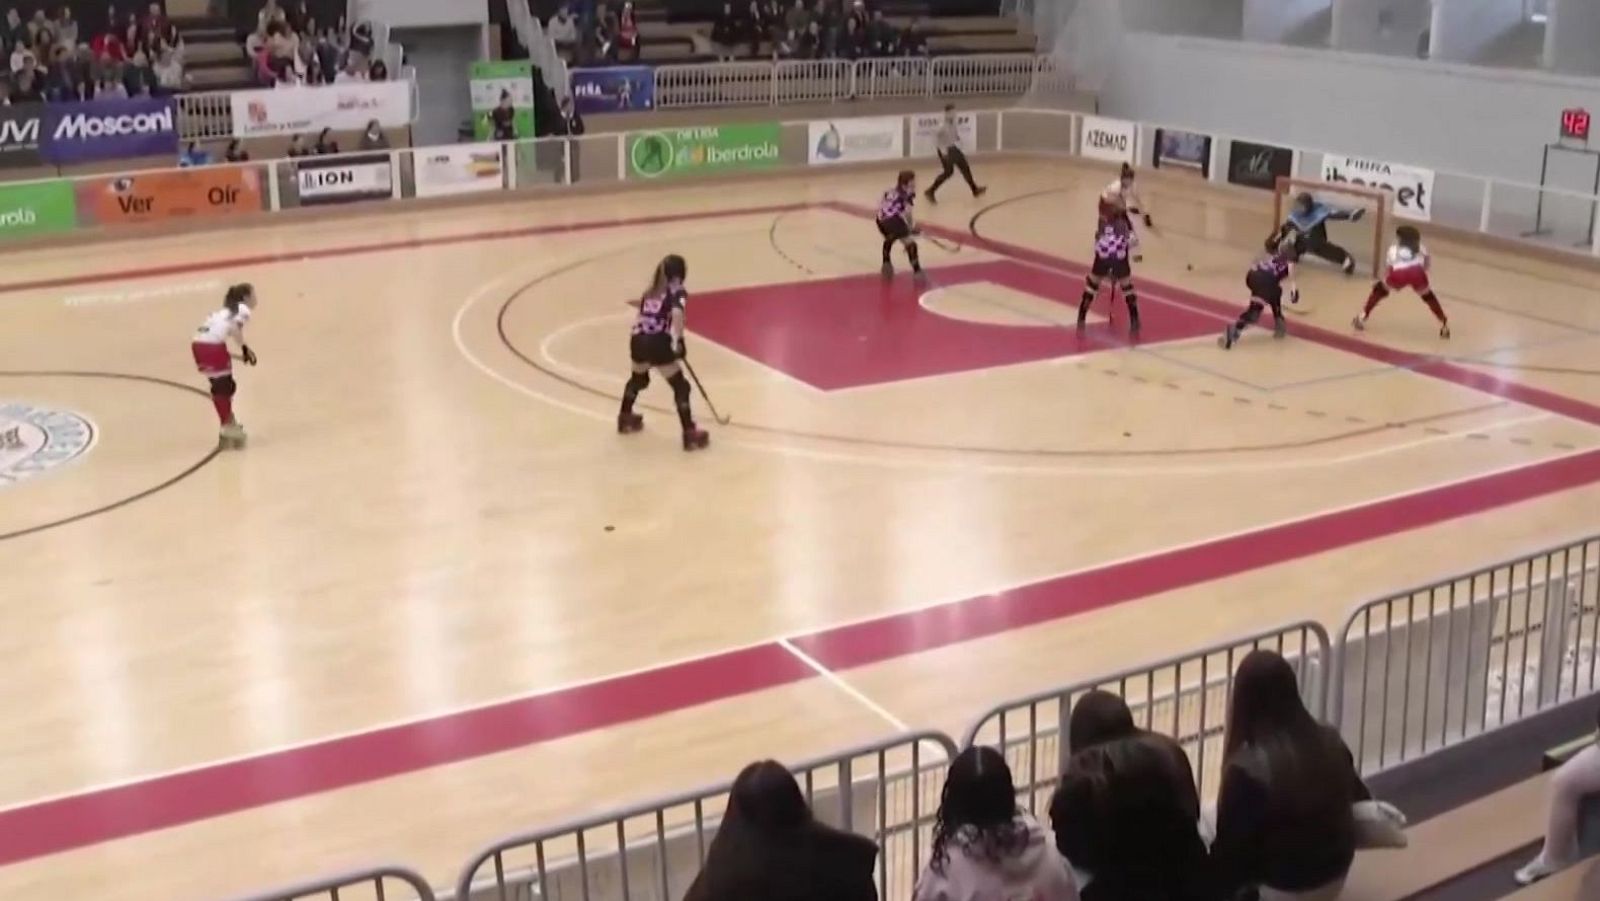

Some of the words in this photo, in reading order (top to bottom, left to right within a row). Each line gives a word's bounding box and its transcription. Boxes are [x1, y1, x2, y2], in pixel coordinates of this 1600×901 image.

[53, 105, 173, 142] Mosconi
[1563, 112, 1588, 135] 42
[707, 141, 779, 163] Iberdrola
[1344, 157, 1392, 176] FIBRA
[117, 195, 154, 214] Ver
